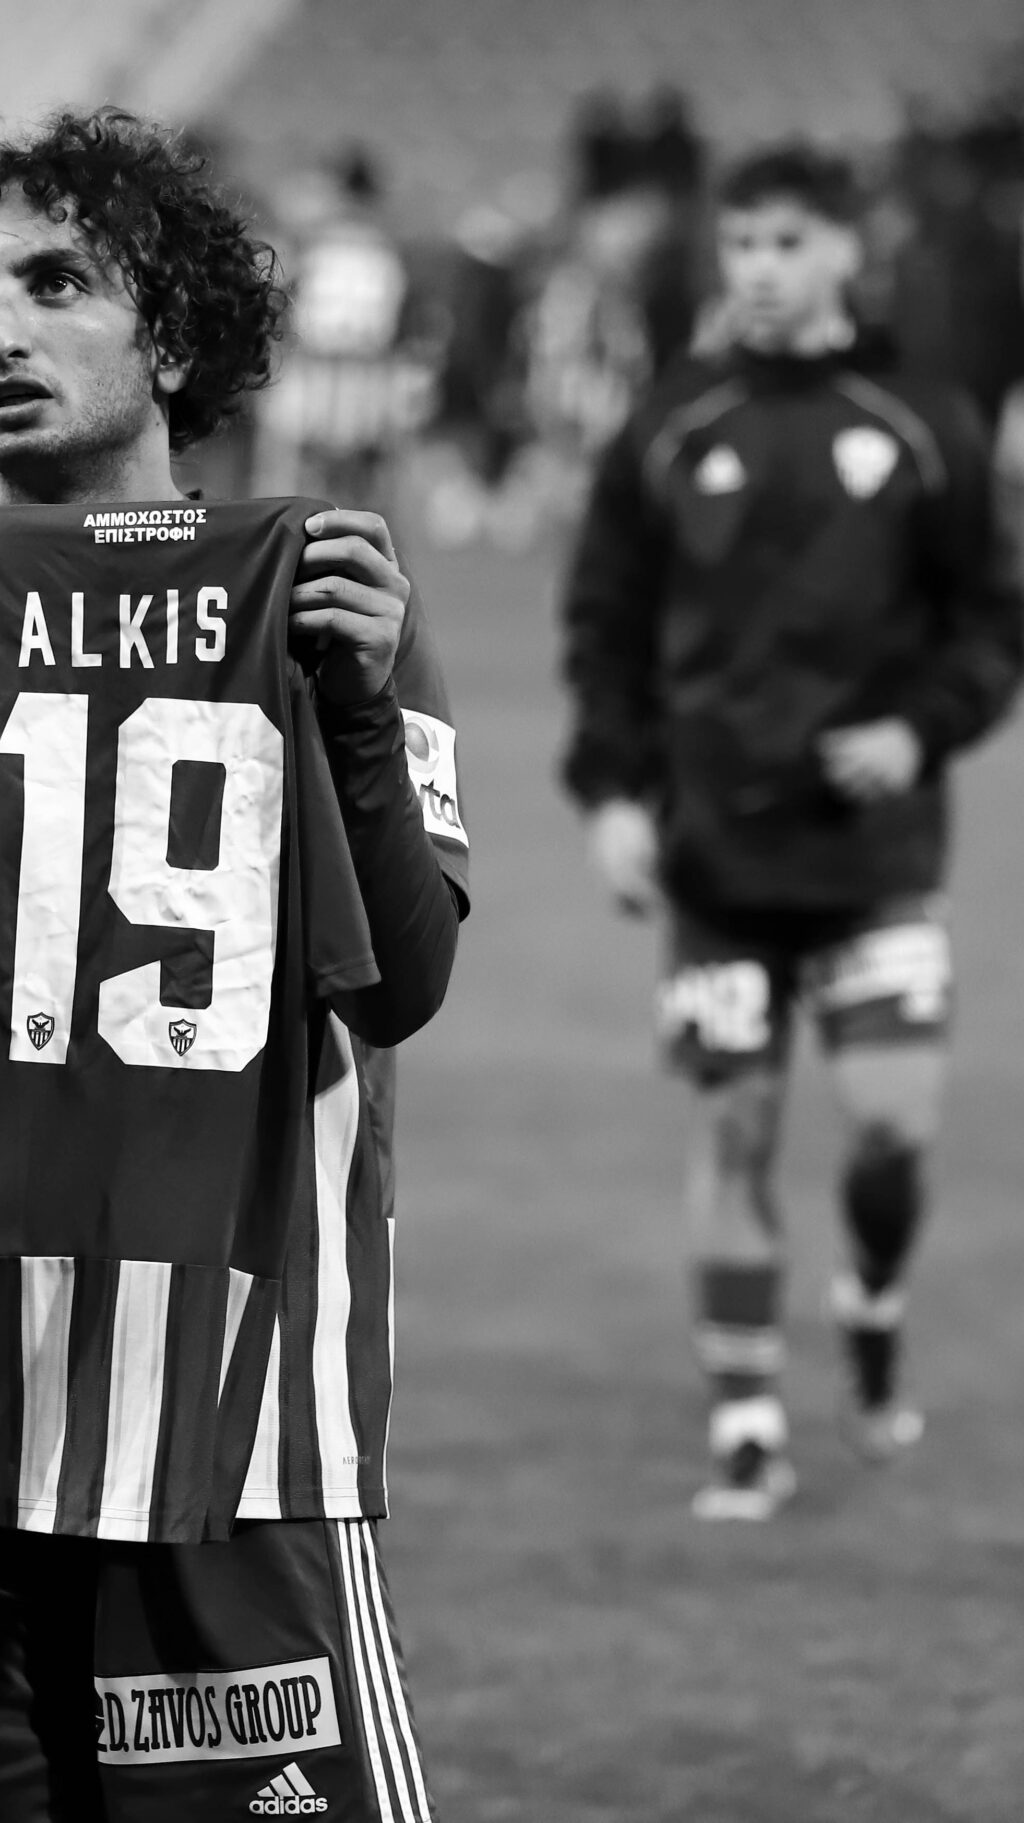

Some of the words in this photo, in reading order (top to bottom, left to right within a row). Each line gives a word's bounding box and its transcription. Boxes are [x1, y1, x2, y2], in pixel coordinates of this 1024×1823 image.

[83, 508, 207, 528] ΑΜΜΟΧΩΣΤΟΣ
[94, 526, 196, 544] ΕΠΙΣΤΡΟΦΗ
[18, 586, 228, 669] ALKIS
[225, 1674, 322, 1745] GROUP
[248, 1795, 329, 1815] adidas
